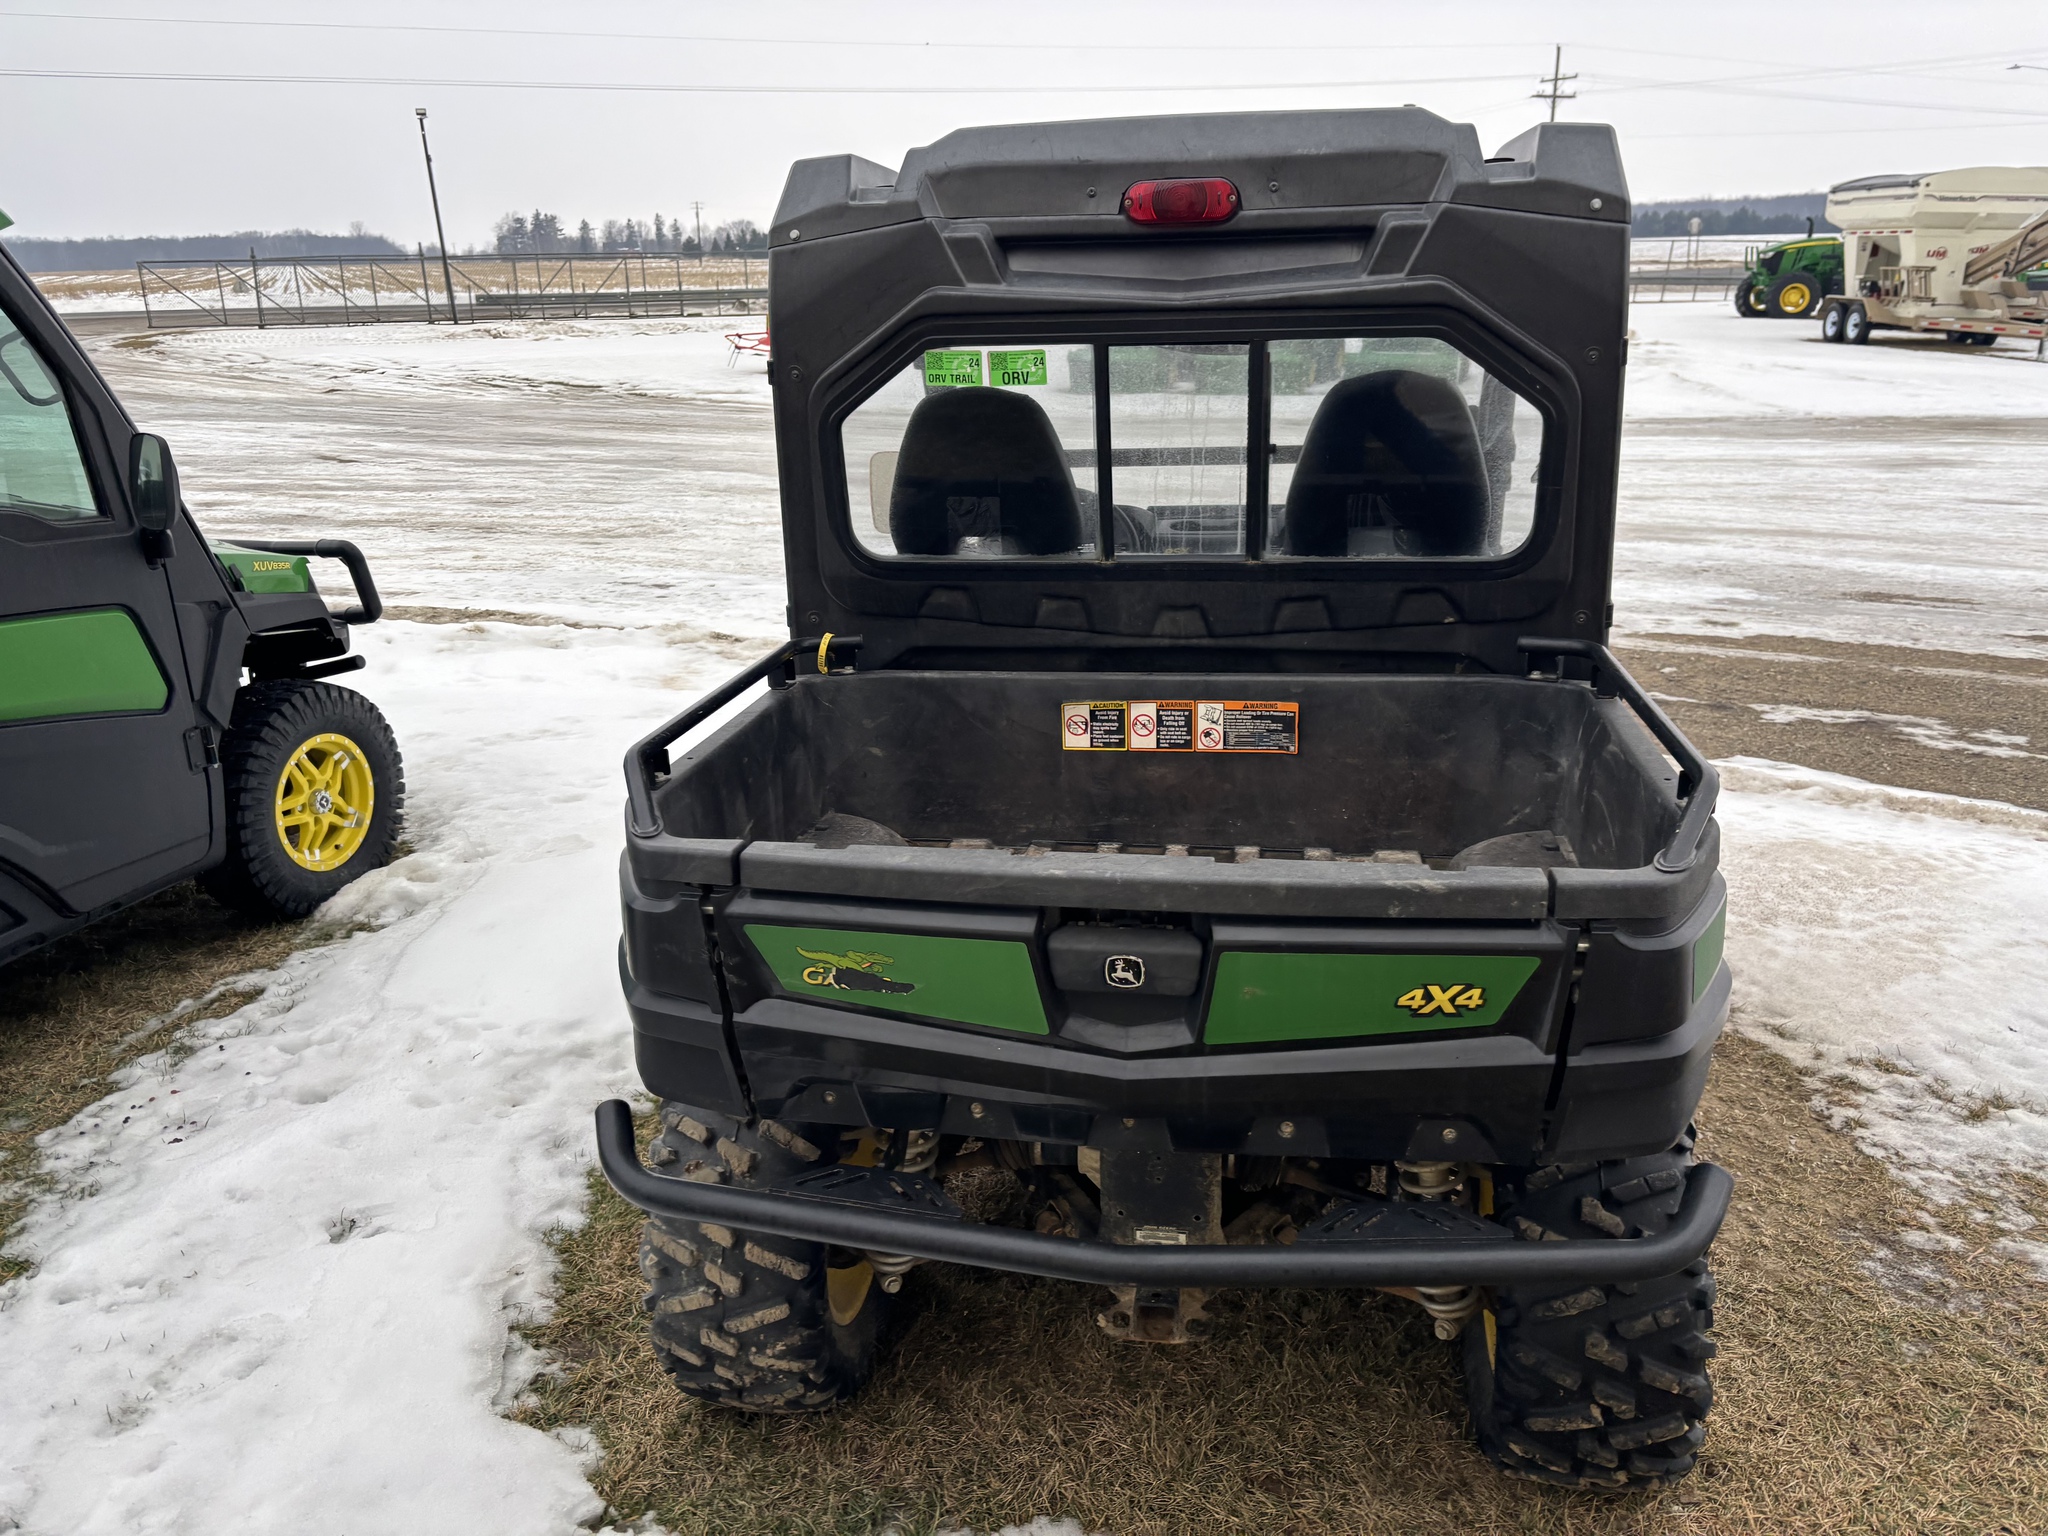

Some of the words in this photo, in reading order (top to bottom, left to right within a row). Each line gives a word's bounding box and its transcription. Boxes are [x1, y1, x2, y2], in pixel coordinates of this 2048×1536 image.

[968, 358, 980, 368] 24
[1033, 357, 1045, 367] 24
[928, 373, 947, 383] ORV
[949, 373, 976, 384] TRAIL
[1001, 371, 1030, 385] ORV
[1397, 985, 1484, 1014] 4X4
